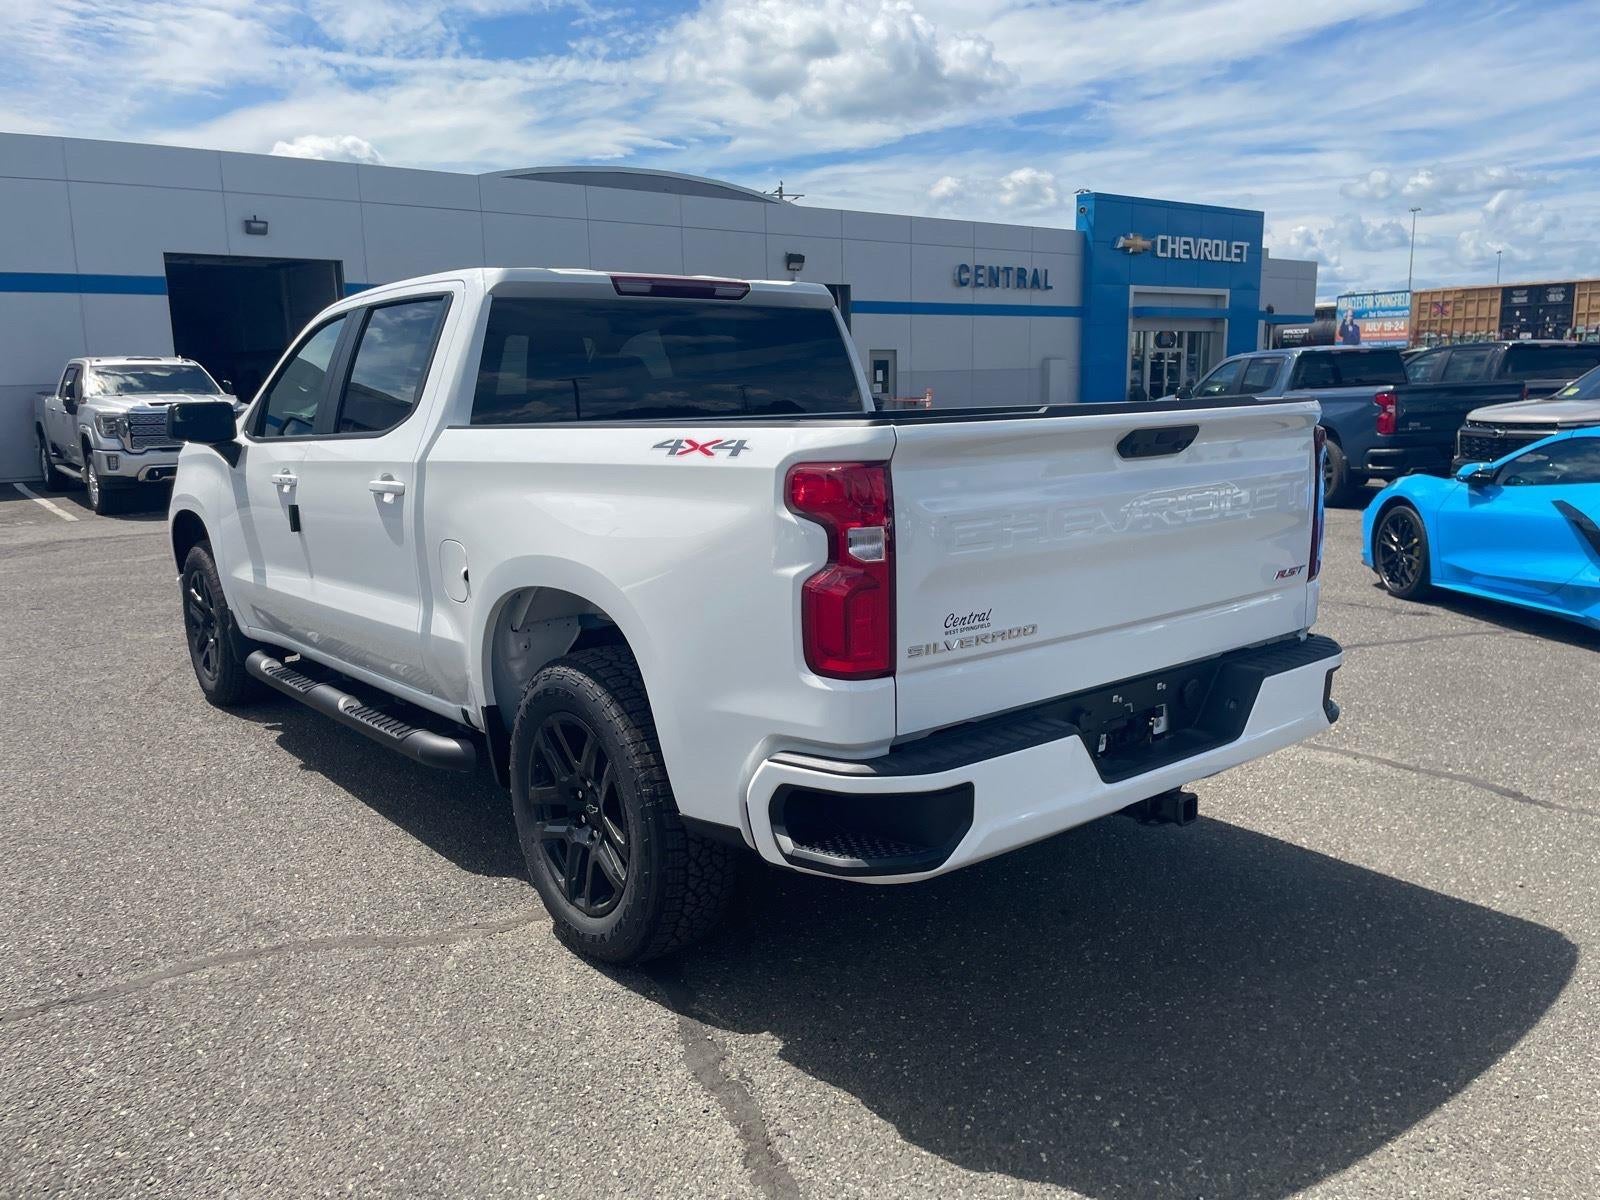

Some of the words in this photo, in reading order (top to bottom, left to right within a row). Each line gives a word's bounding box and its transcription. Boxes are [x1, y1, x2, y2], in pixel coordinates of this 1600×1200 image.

[1157, 234, 1250, 263] CHEVROLET
[954, 263, 1053, 290] CENTRAL
[1363, 295, 1374, 309] FOR
[1375, 292, 1410, 307] SPRINGFIELD
[1365, 322, 1382, 332] JULY
[1384, 321, 1405, 332] 19-24
[944, 608, 993, 629] Central
[945, 628, 959, 636] WEST
[959, 622, 991, 634] SPRINGFIELD
[907, 623, 1038, 659] SILVERADO
